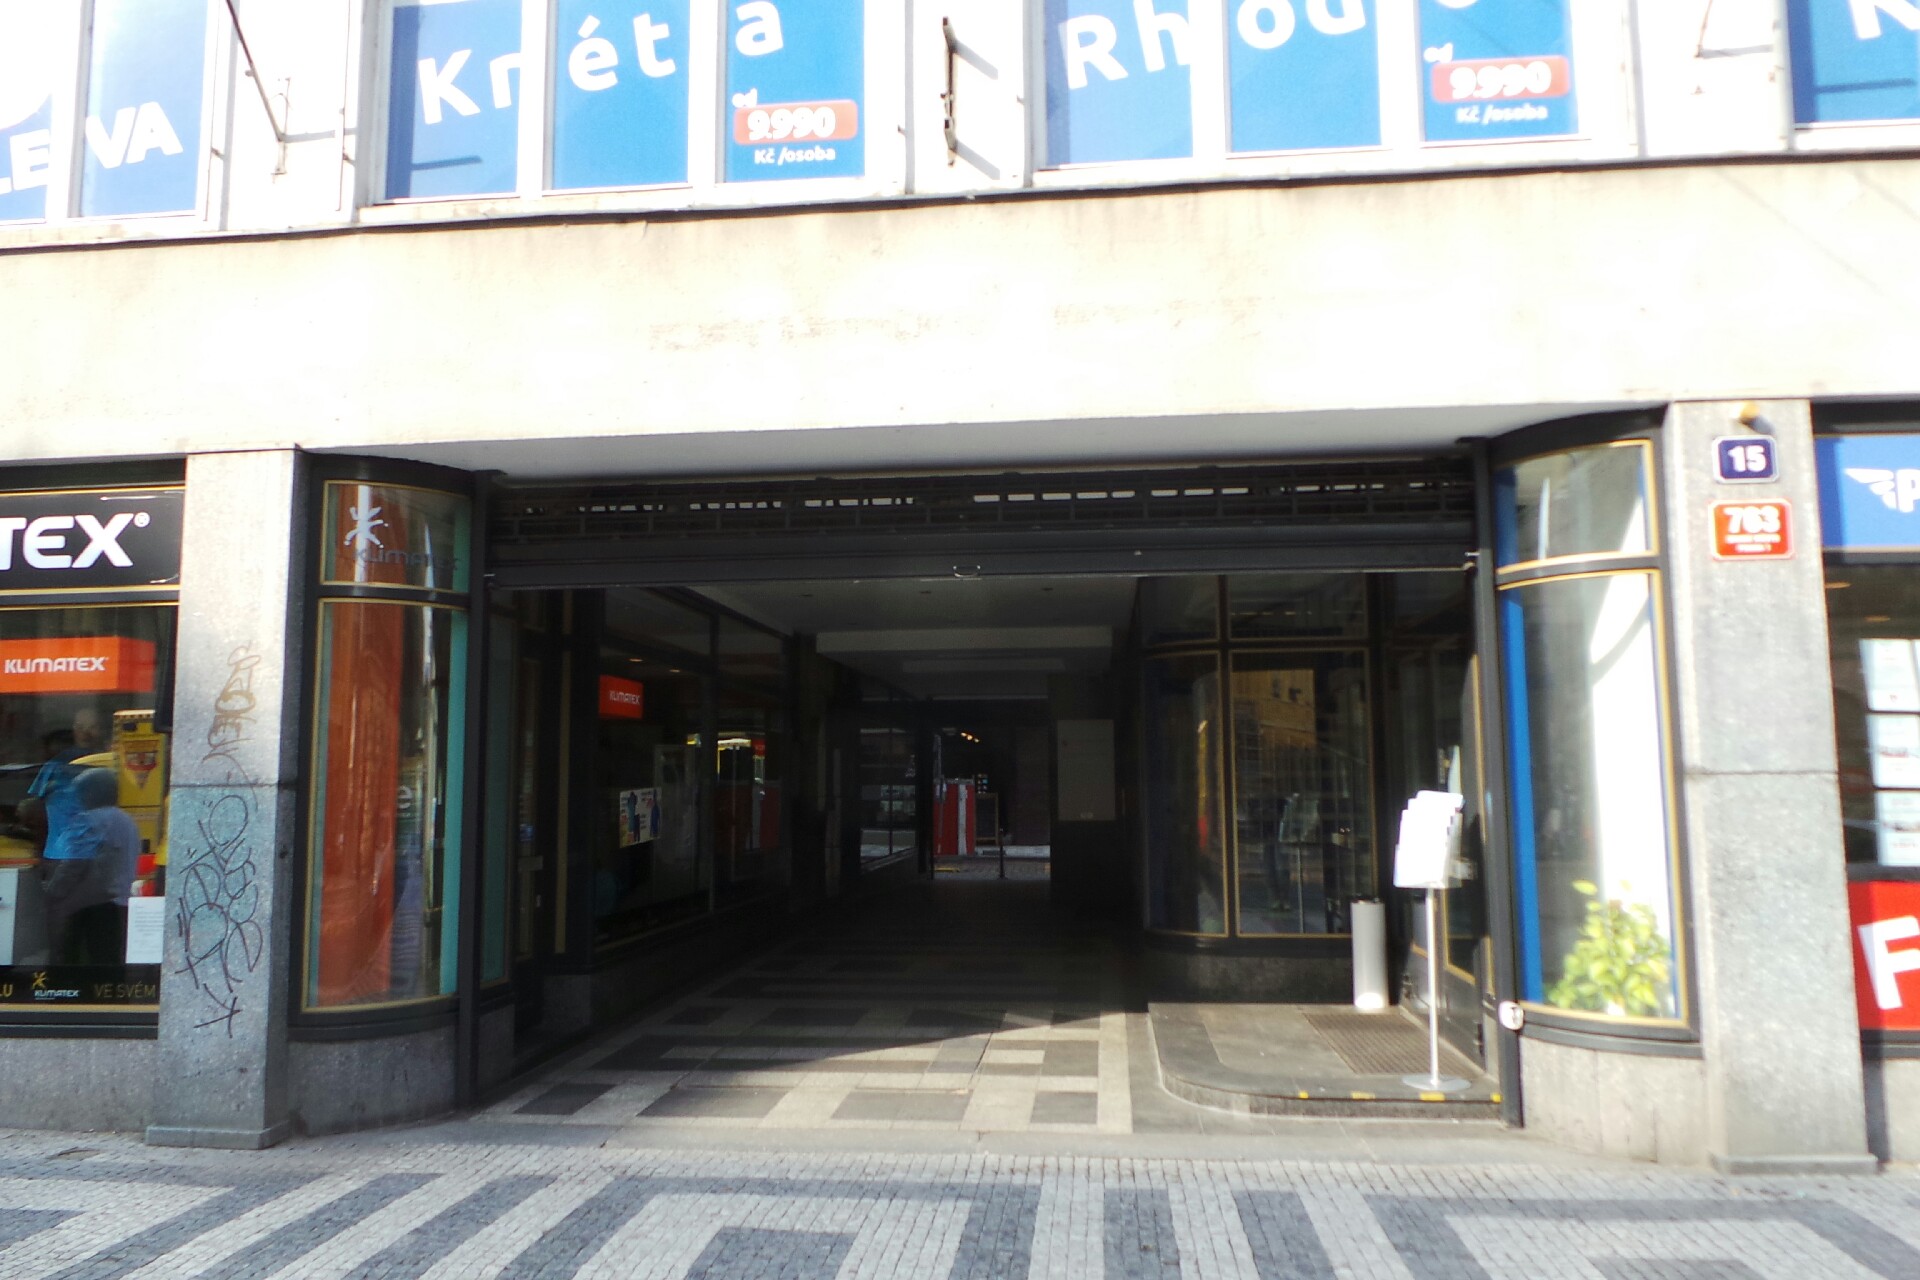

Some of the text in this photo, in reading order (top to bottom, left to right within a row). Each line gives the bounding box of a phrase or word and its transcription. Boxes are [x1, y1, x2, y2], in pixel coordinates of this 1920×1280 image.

[418, 0, 784, 125] Kréta
[754, 147, 775, 164] Kč
[1728, 445, 1766, 472] 15
[5, 657, 106, 673] KLIMATEX
[34, 989, 79, 997] KLIMATEX
[94, 981, 155, 998] VE SVÉM
